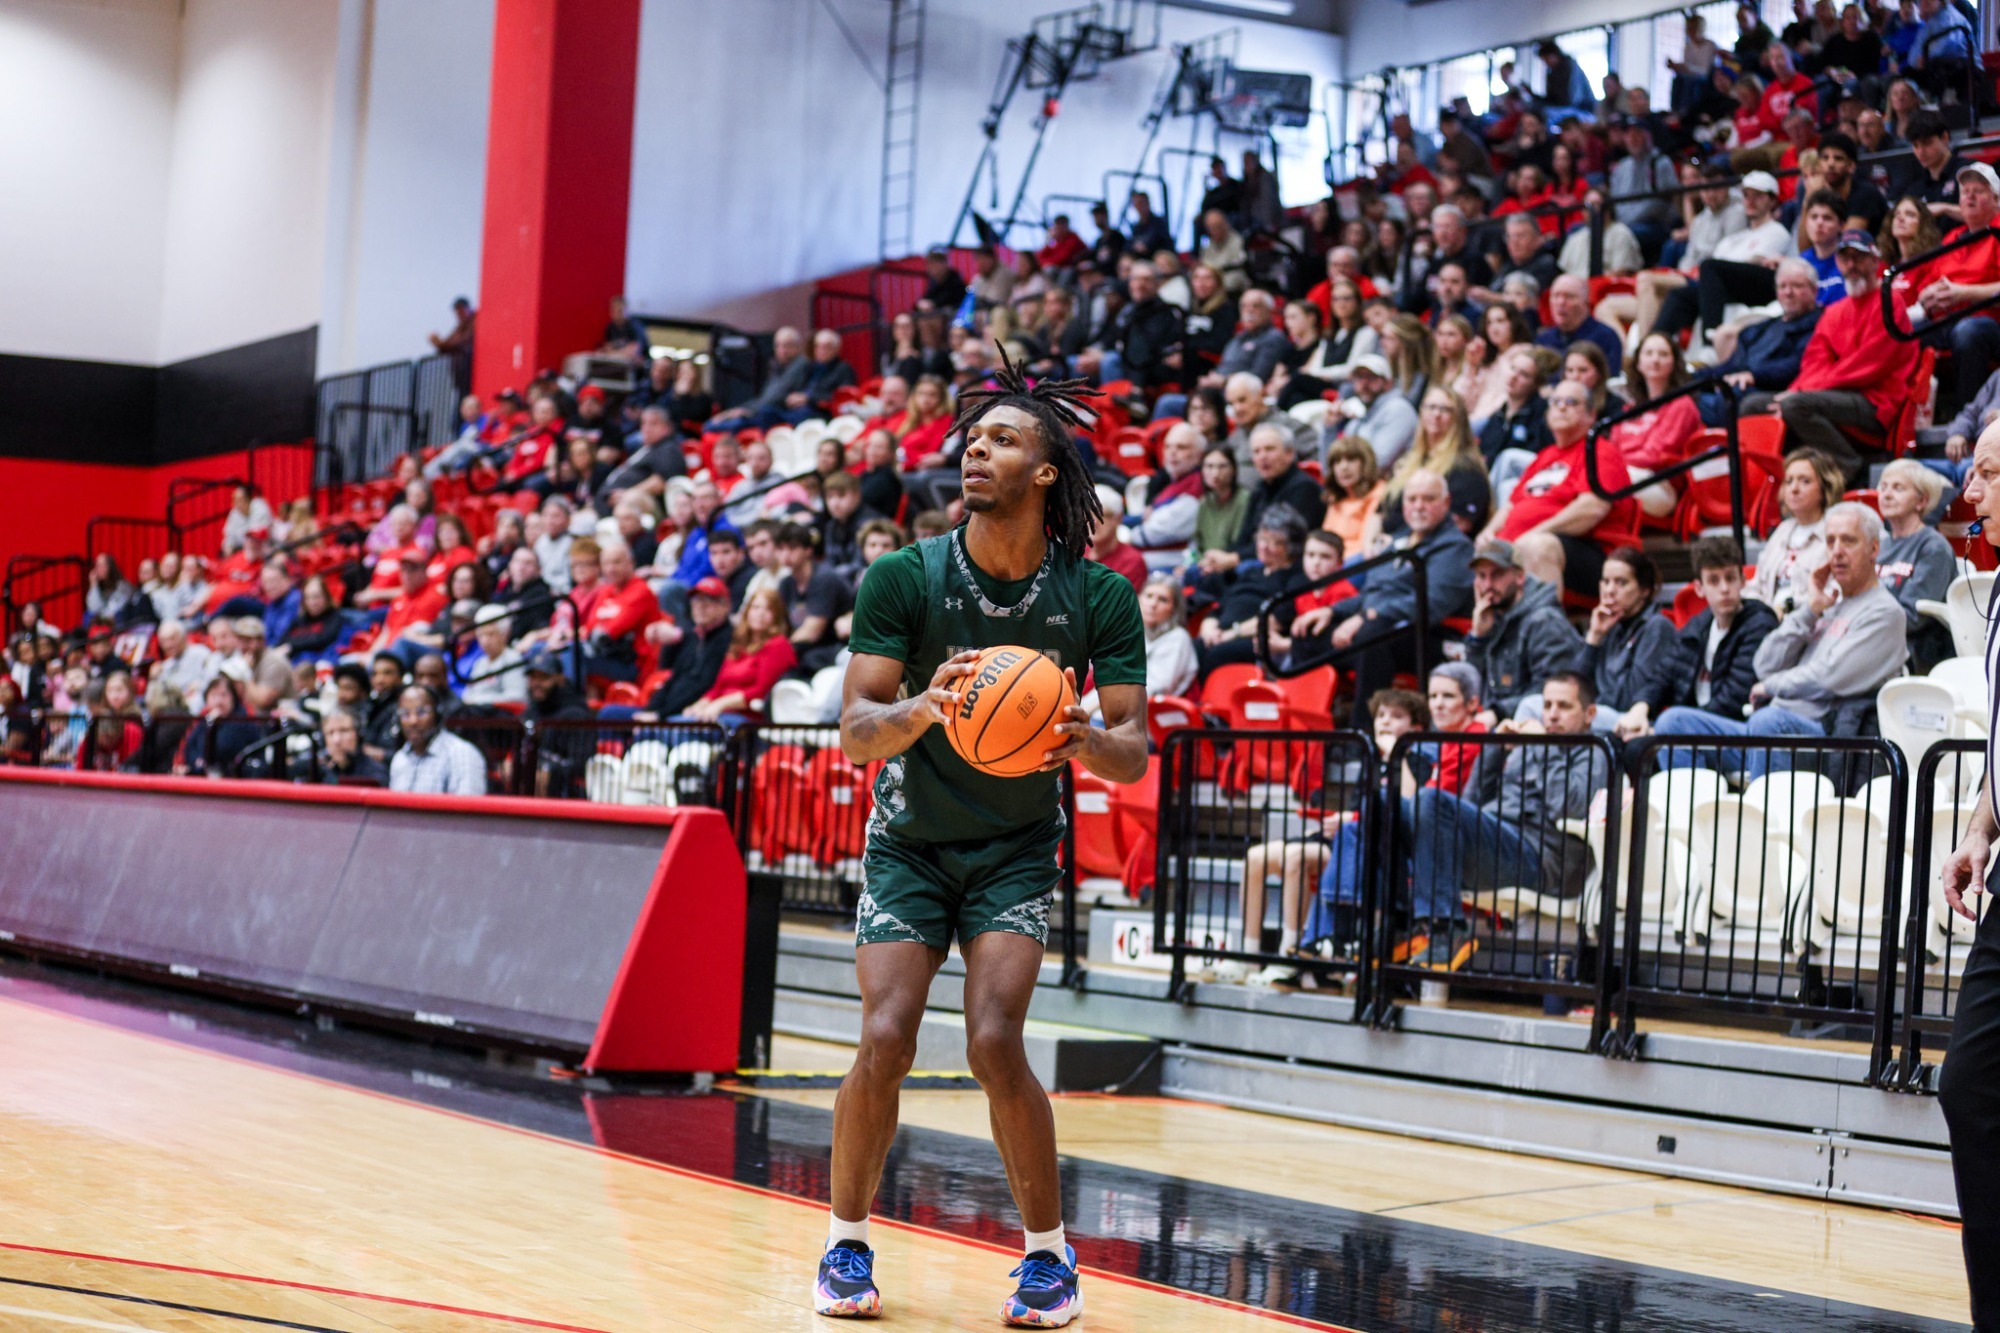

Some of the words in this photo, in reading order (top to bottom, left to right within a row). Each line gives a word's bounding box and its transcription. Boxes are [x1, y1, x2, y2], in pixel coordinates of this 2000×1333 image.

[1046, 614, 1068, 624] NEC
[960, 651, 1023, 720] Wilson
[1016, 691, 1038, 720] SFU
[1127, 926, 1139, 960] C
